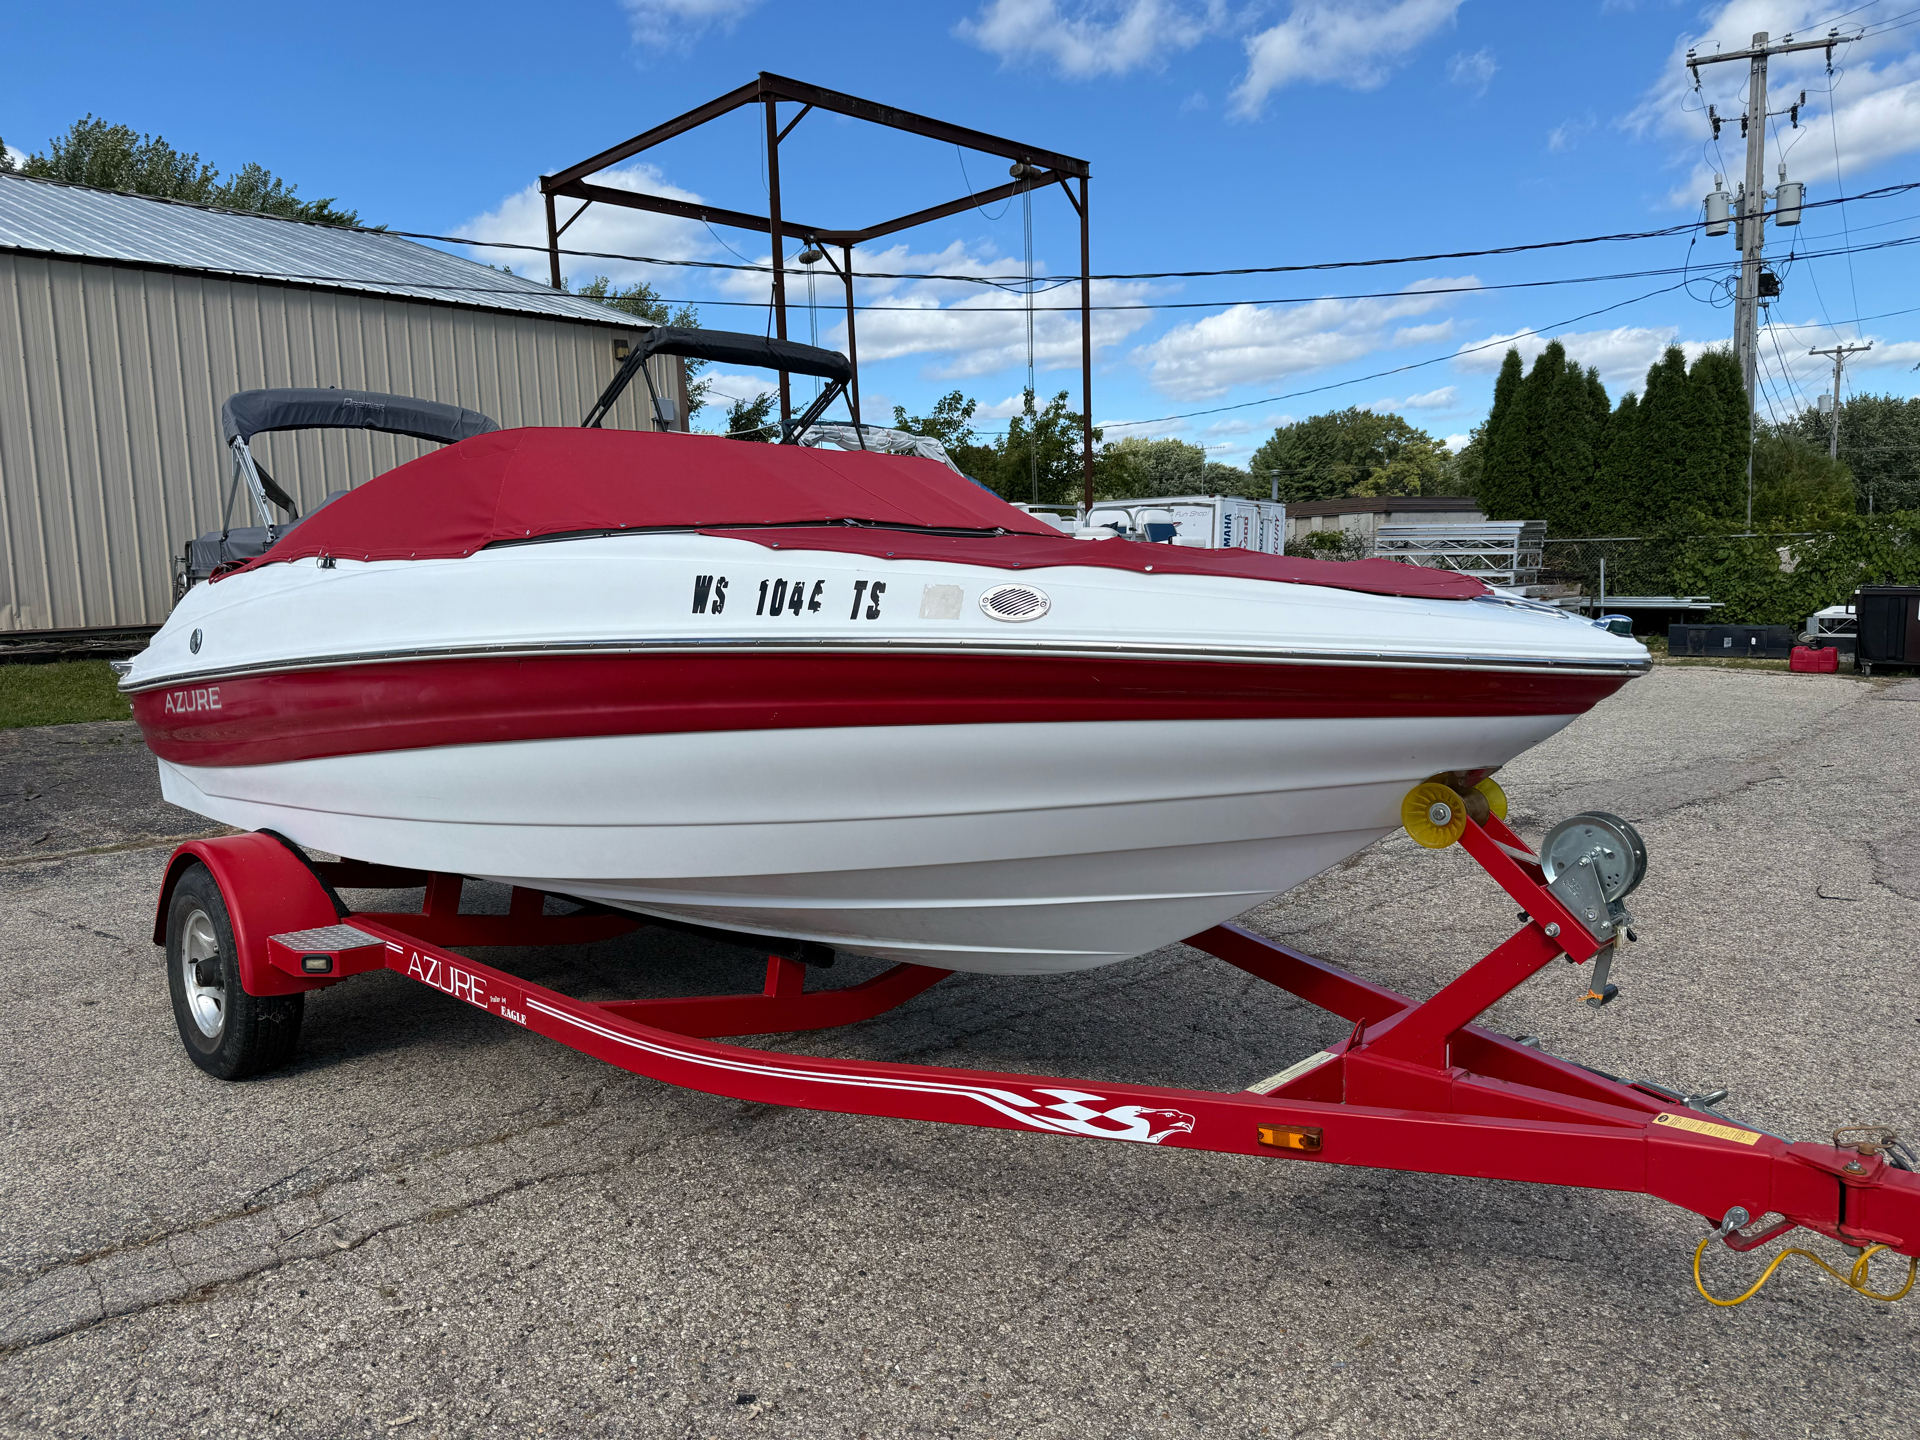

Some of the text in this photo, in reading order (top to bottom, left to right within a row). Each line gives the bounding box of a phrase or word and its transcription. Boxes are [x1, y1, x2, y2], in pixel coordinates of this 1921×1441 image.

[1189, 509, 1211, 517] Shop!
[1223, 513, 1232, 548] MAHA
[691, 575, 729, 615] WS
[849, 580, 887, 620] TS
[165, 686, 222, 714] AZURE
[407, 951, 488, 1009] AZURE
[501, 1005, 527, 1026] EAGLE
